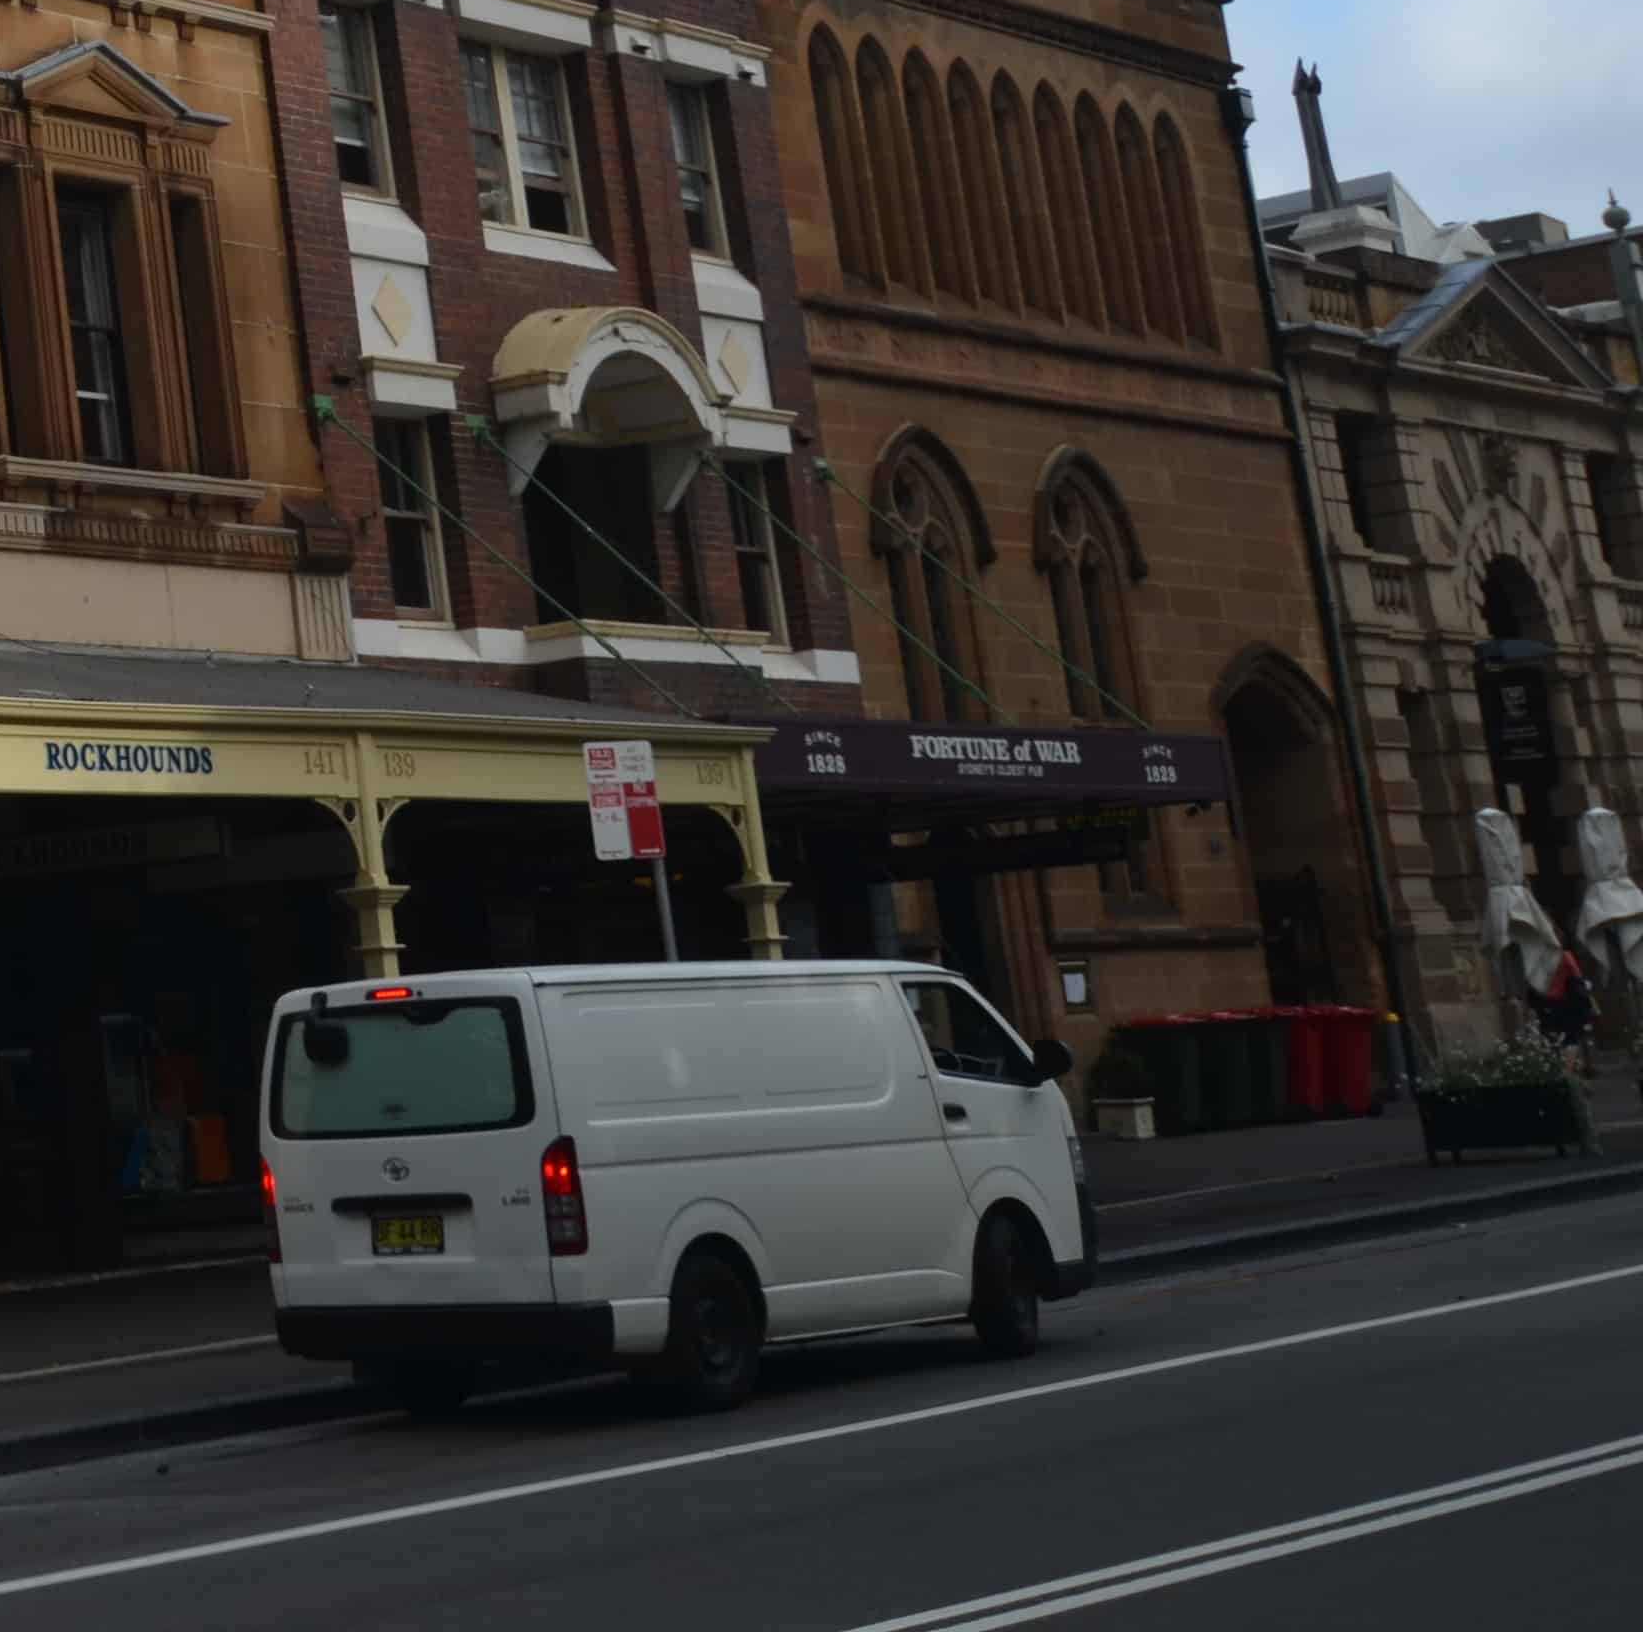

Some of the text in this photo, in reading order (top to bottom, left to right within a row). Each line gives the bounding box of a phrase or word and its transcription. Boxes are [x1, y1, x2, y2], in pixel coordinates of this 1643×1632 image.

[804, 731, 842, 748] SINCE
[909, 735, 1082, 764] FORTUNE of WAR
[45, 742, 213, 774] ROCKHOUNDS
[303, 750, 337, 776] 141
[383, 751, 417, 779] 139
[806, 753, 847, 774] 1828
